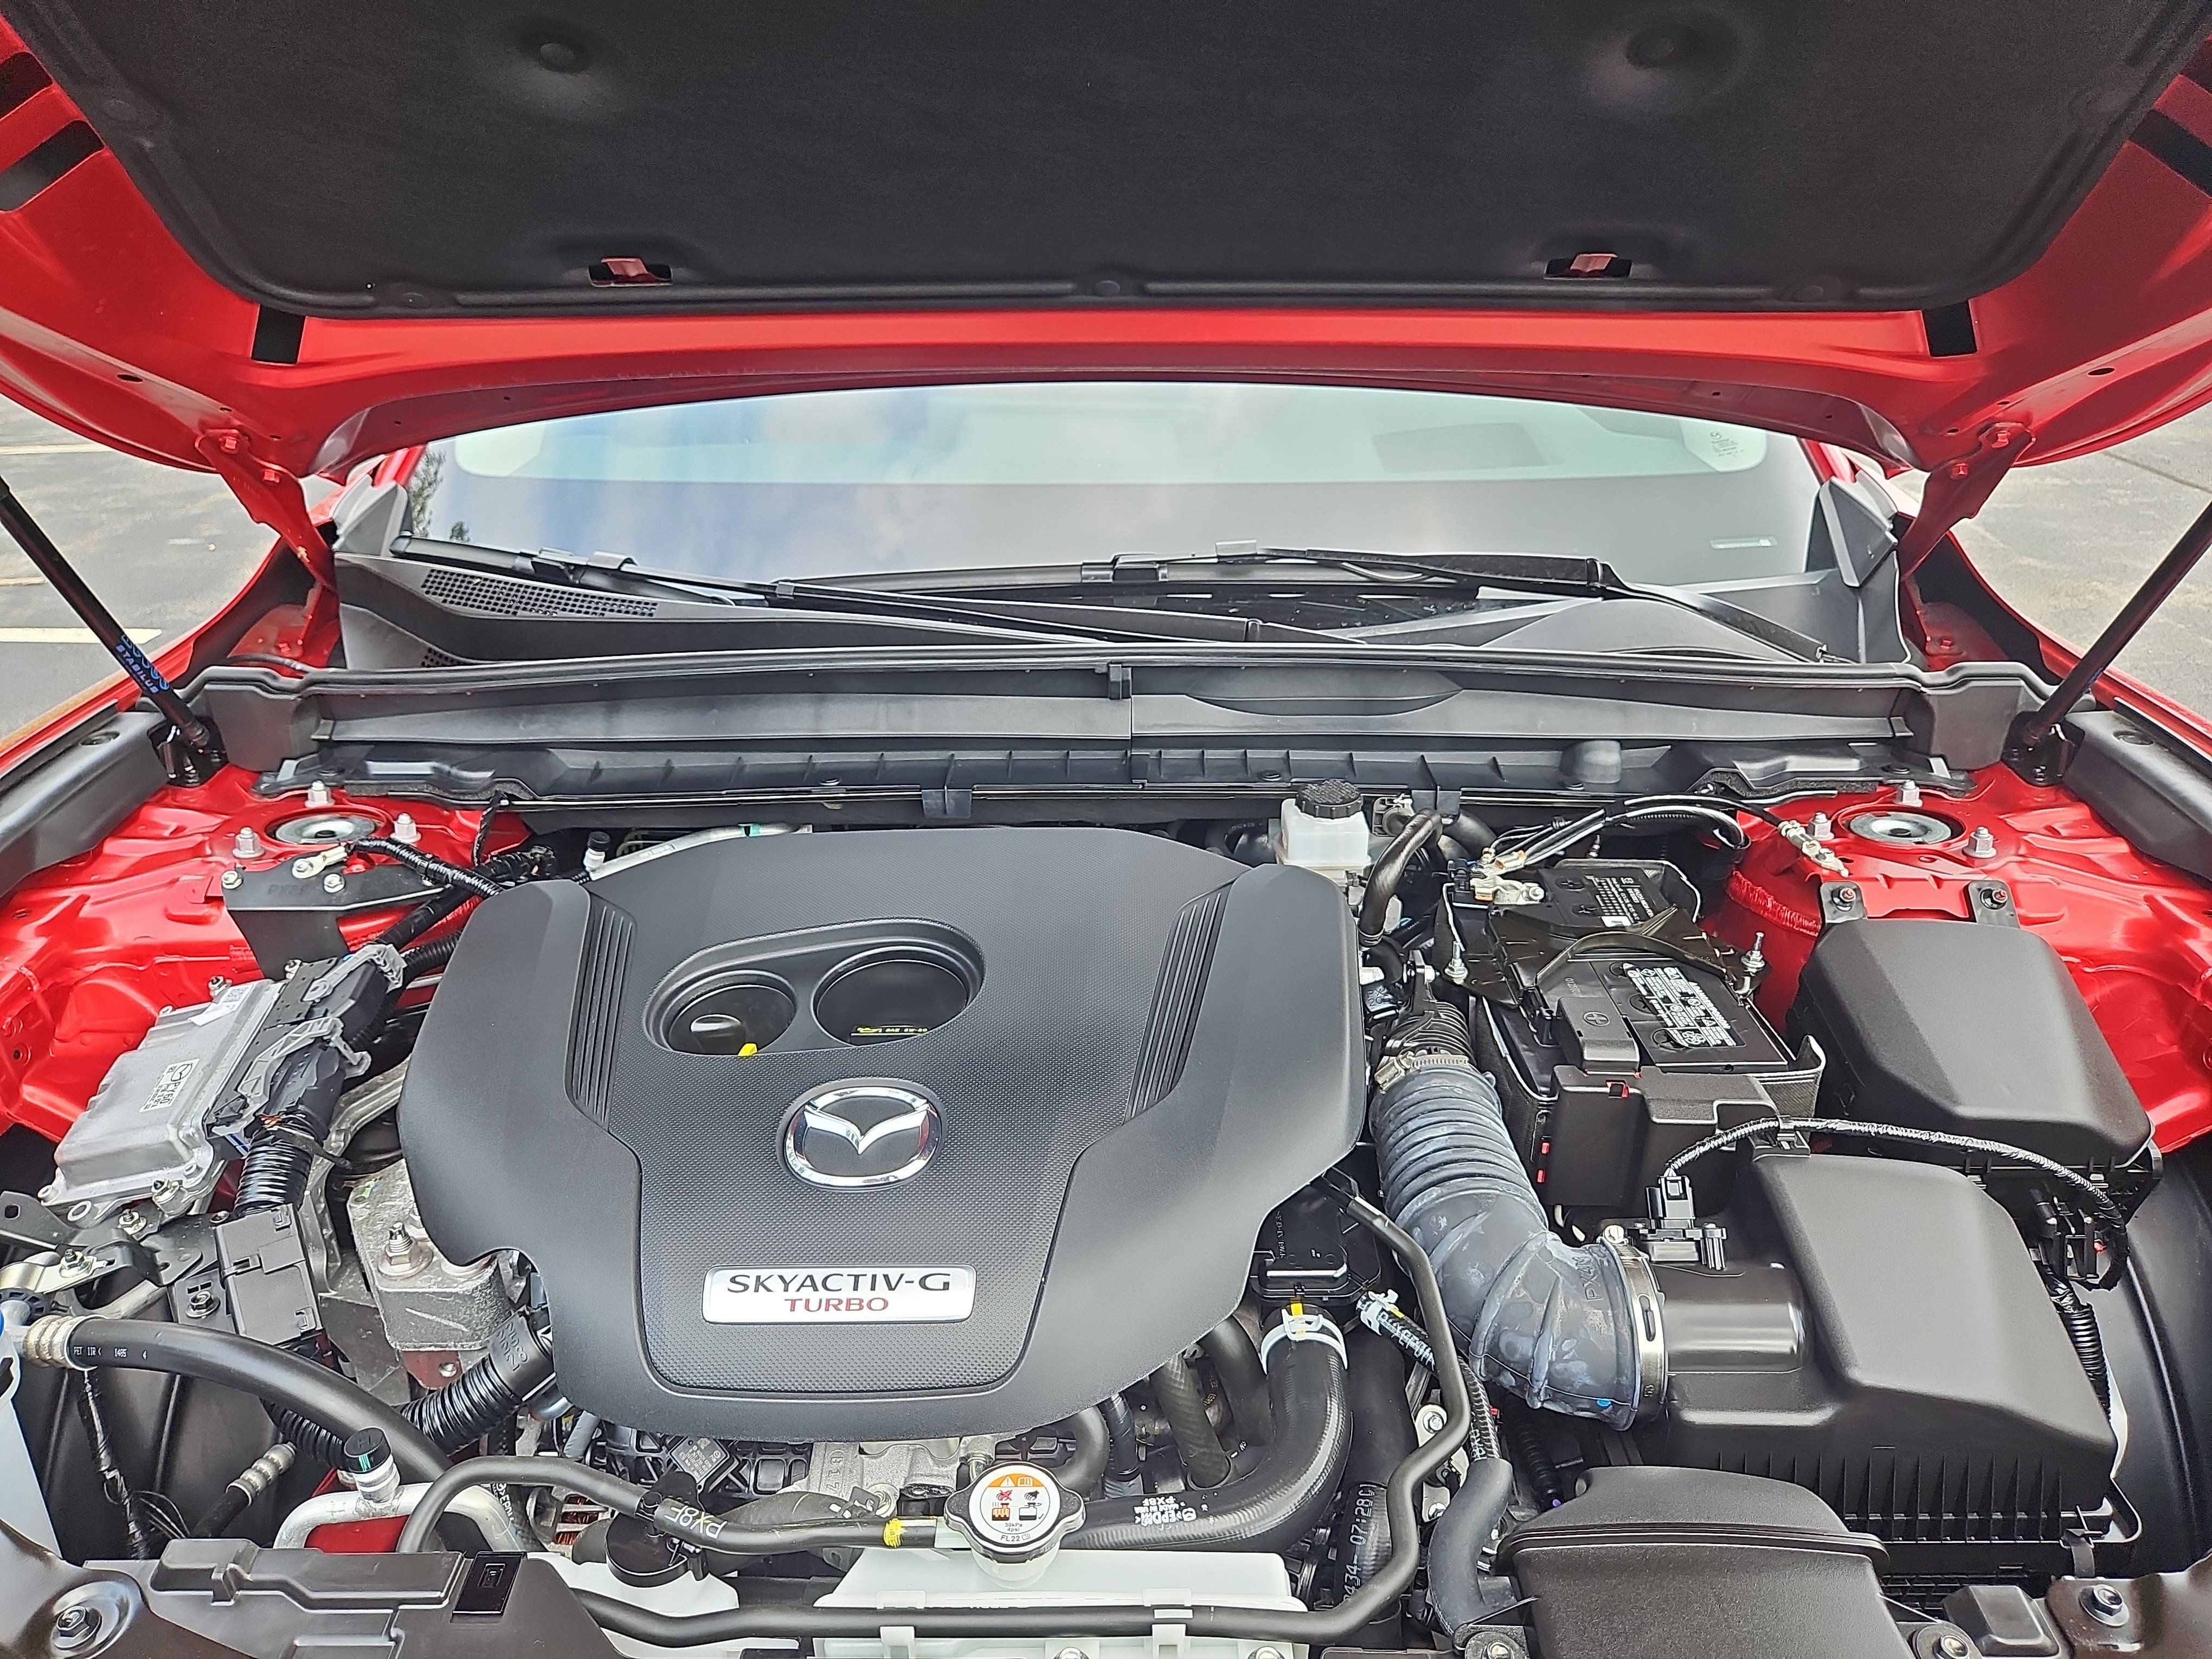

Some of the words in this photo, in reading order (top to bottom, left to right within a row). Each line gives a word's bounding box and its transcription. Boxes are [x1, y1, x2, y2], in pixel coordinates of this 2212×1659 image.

[116, 644, 160, 694] STABILUS
[728, 1272, 951, 1293] SKYACTIV-G
[784, 1297, 890, 1313] TURBO
